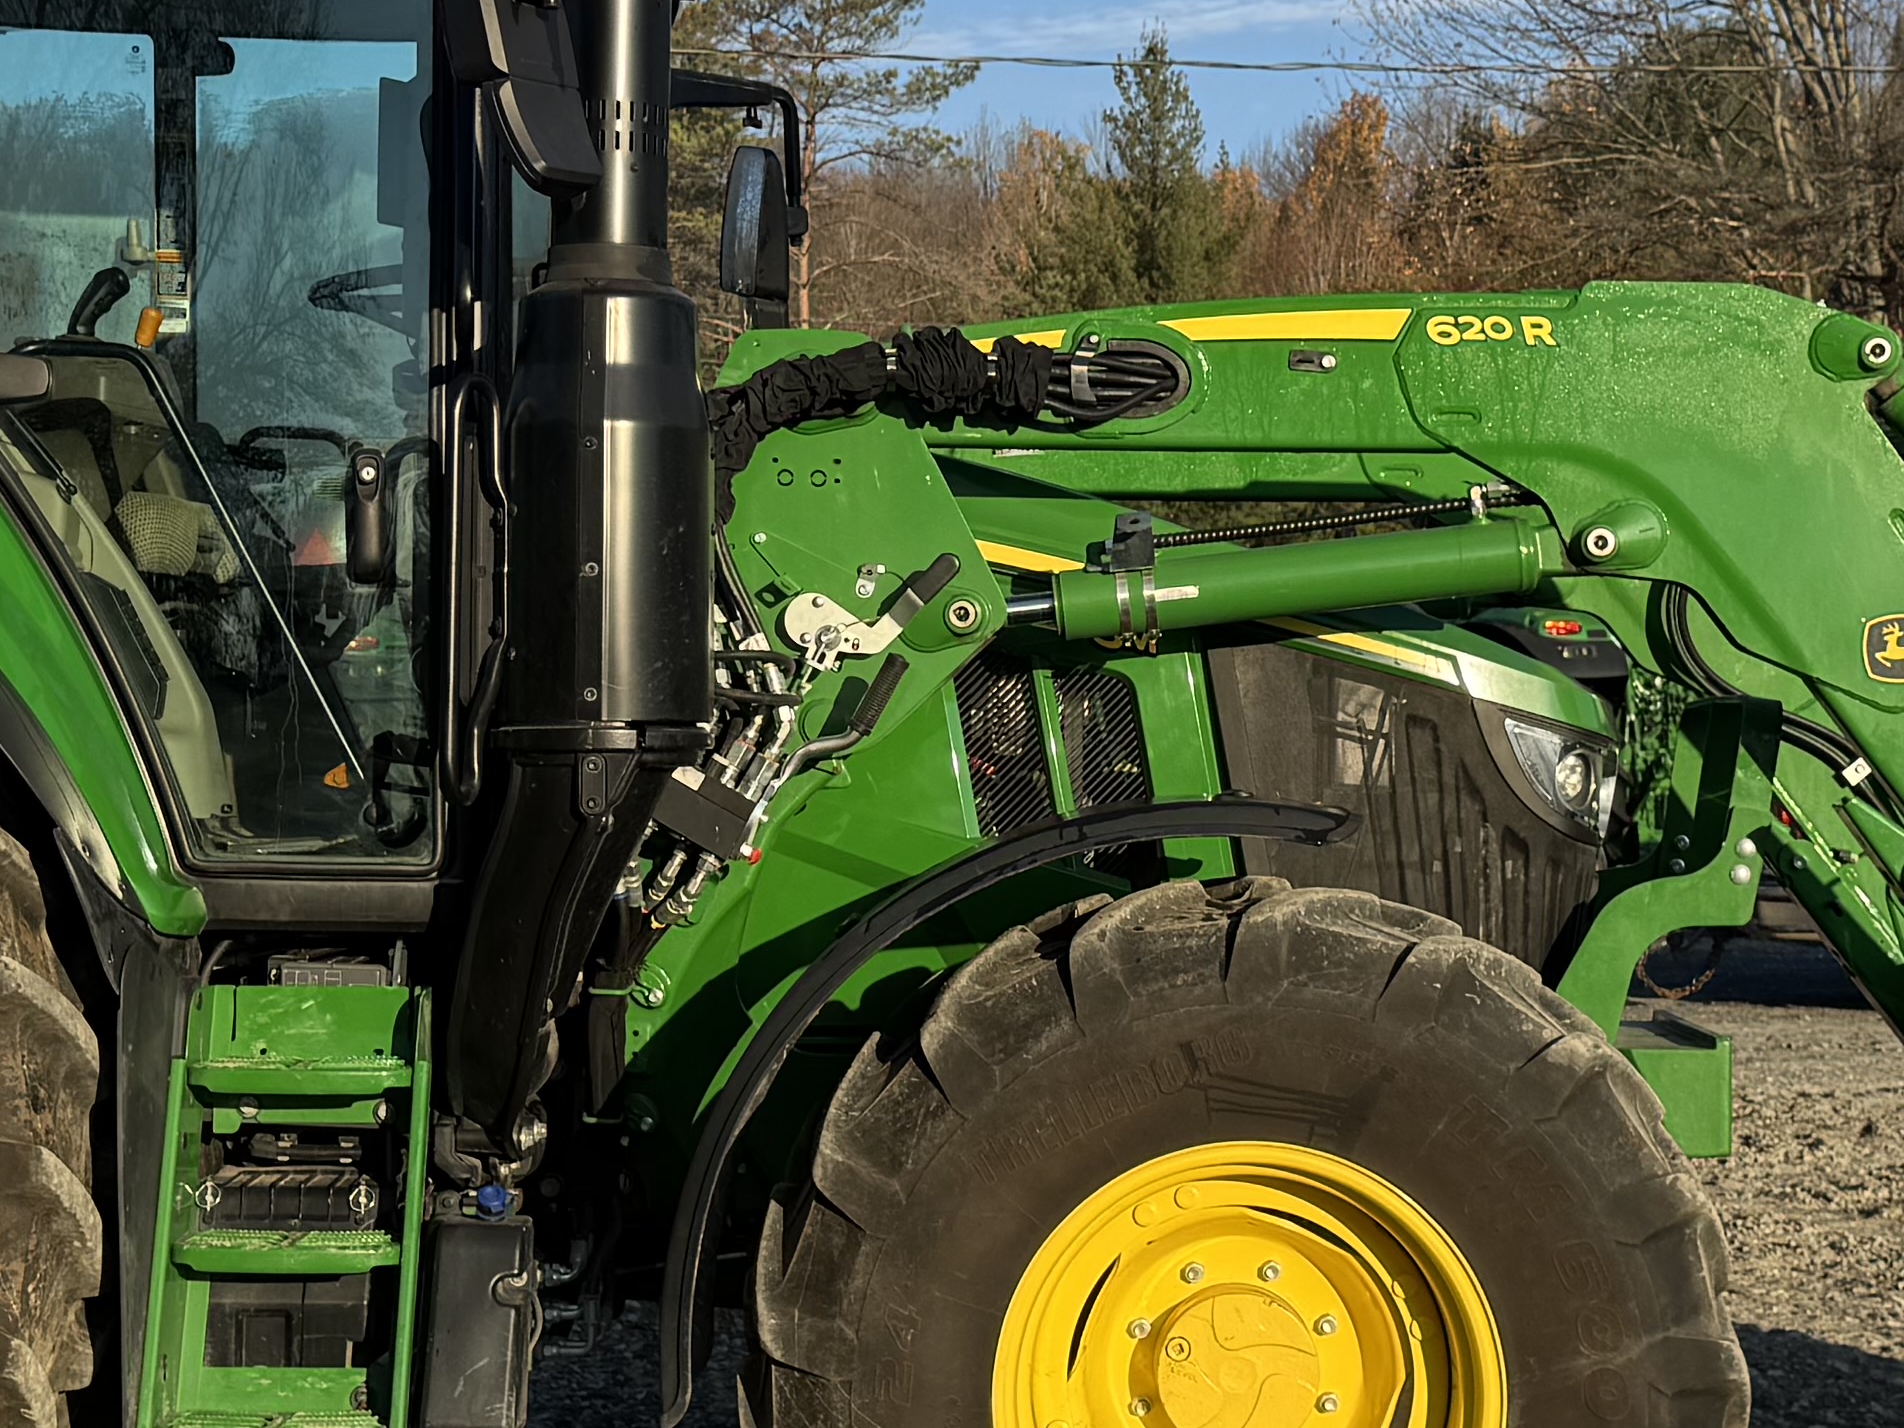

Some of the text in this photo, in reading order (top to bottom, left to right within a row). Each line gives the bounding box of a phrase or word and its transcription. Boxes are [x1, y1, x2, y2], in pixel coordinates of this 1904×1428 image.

[1425, 315, 1558, 346] 620 R
[969, 1023, 1254, 1185] TRELLEBORG
